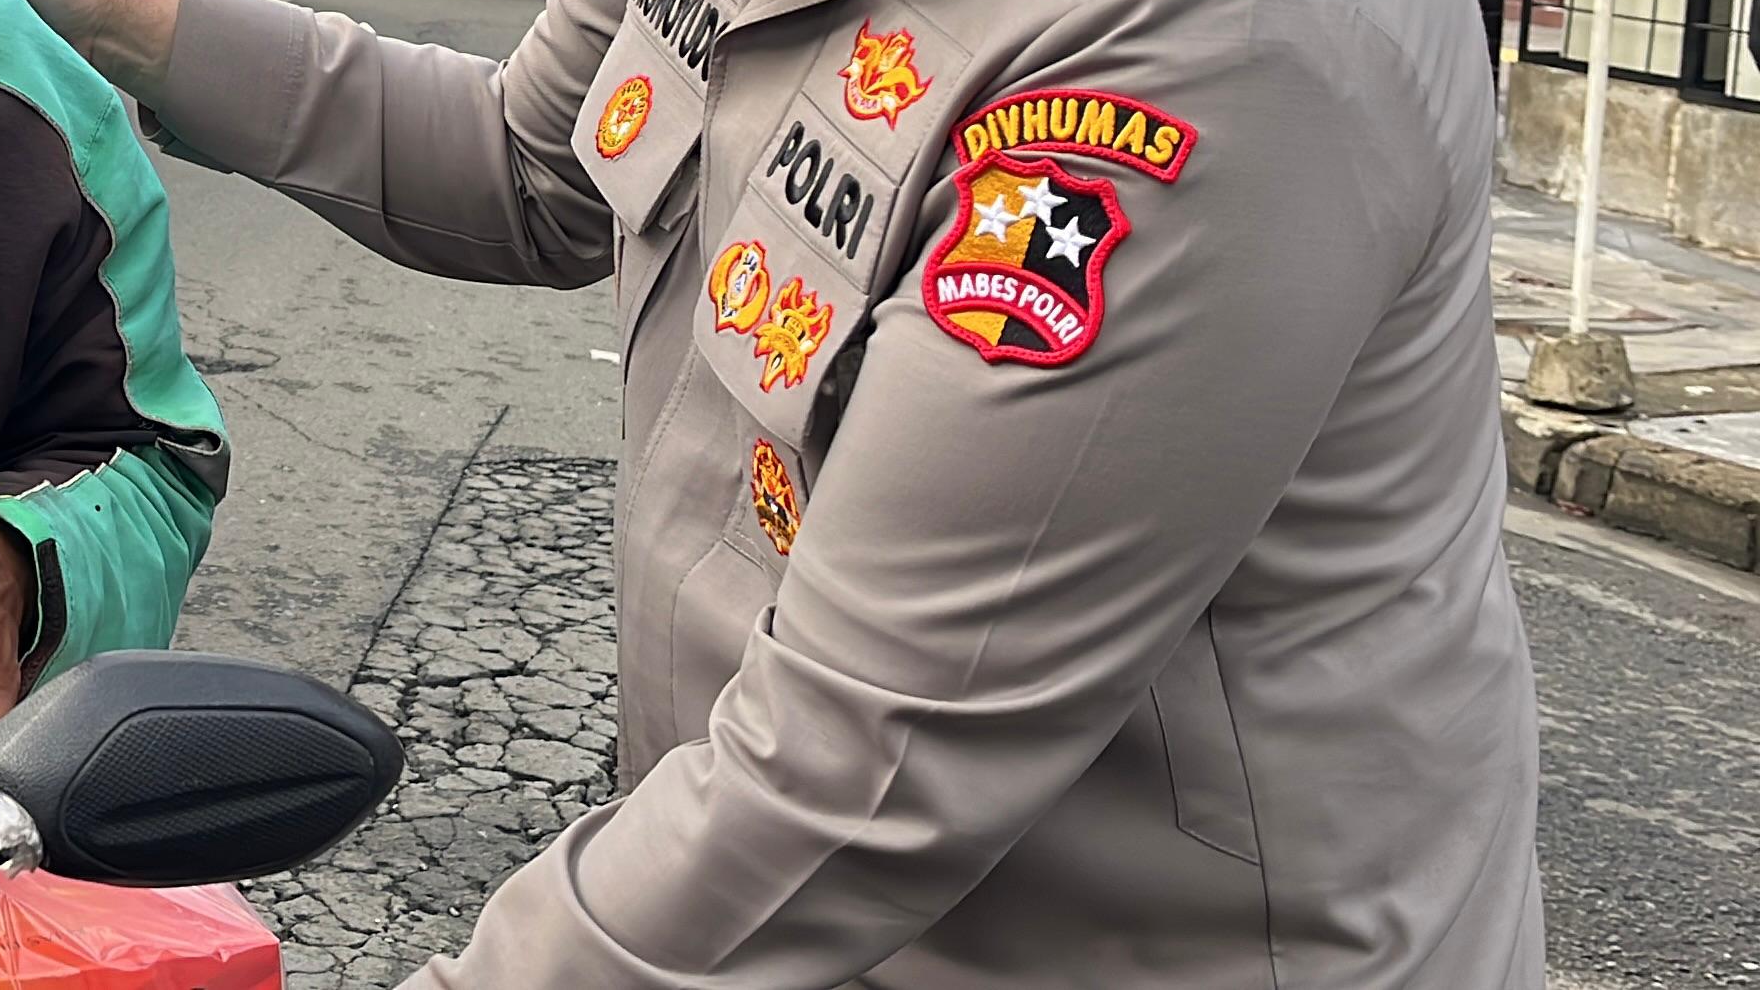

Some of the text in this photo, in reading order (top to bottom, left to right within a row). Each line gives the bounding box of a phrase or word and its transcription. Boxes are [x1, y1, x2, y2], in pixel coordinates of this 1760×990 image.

[964, 97, 1181, 164] DIVHUMAS
[767, 120, 874, 260] POLRI
[937, 273, 1085, 345] MABES POLRI
